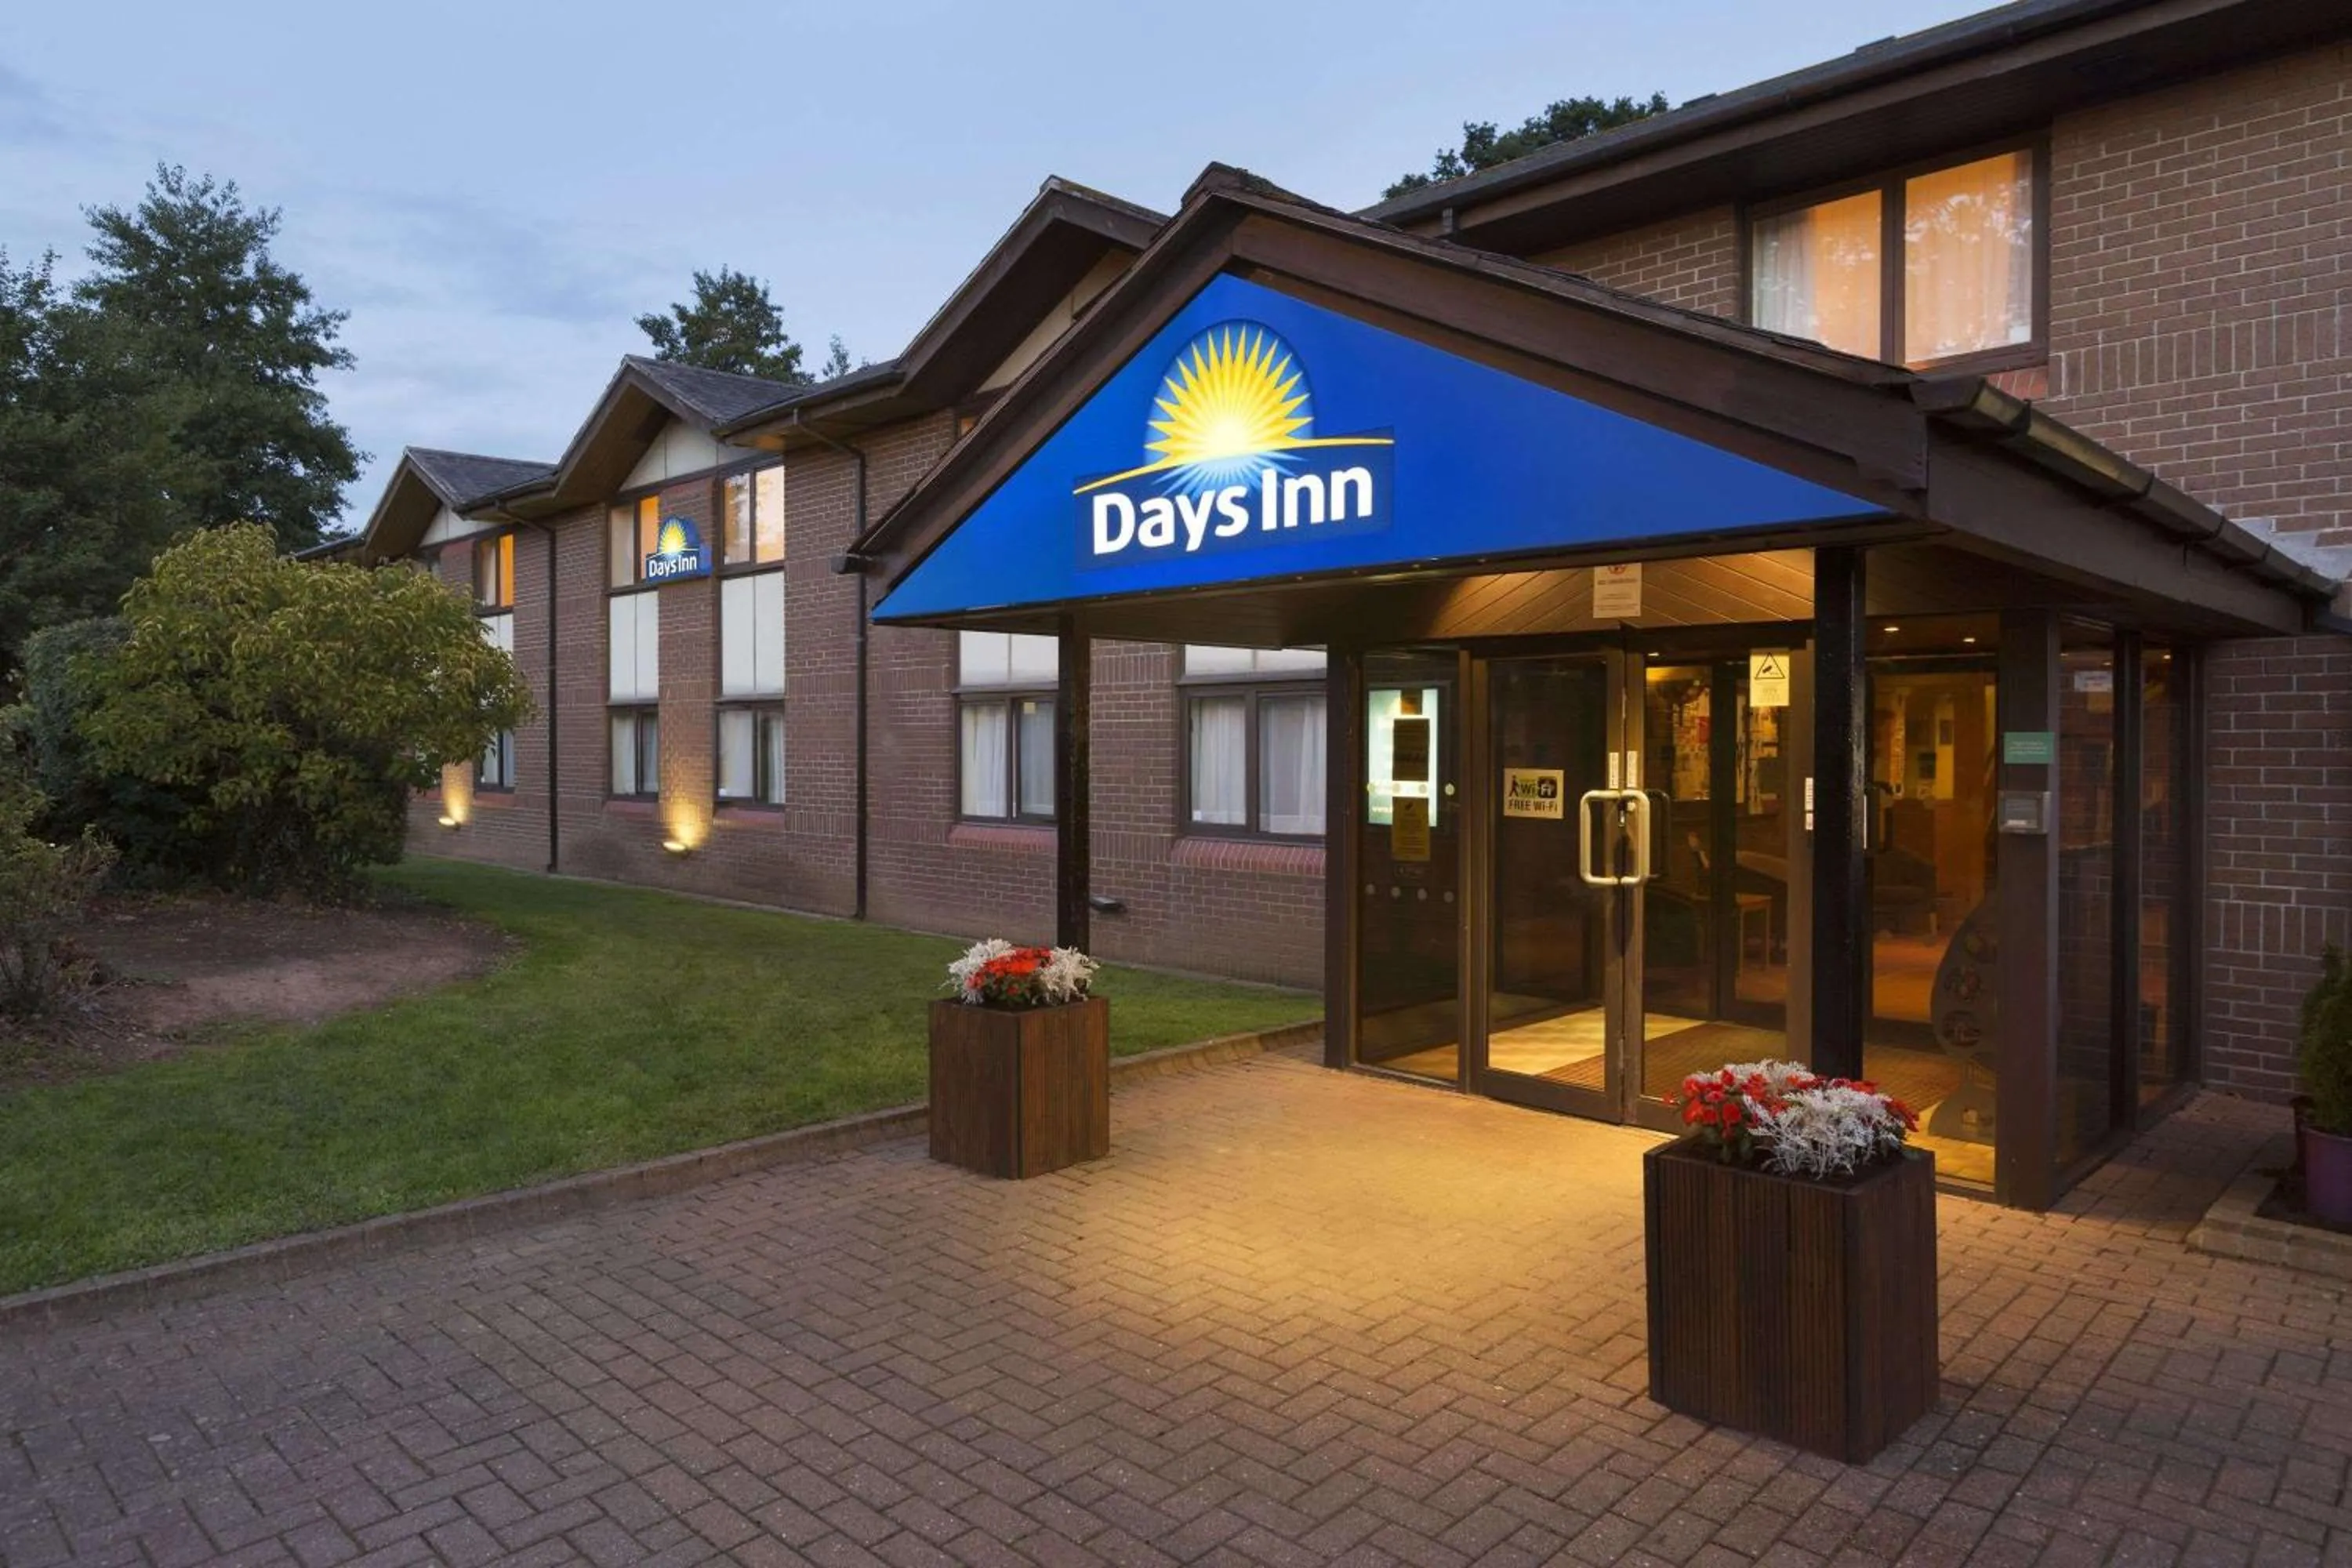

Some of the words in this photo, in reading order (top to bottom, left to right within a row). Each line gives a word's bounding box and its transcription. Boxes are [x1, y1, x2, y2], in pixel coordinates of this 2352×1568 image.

[1093, 485, 1250, 554] Days
[1261, 466, 1374, 532] Inn
[648, 559, 677, 578] Days
[678, 554, 697, 573] Inn
[1508, 799, 1531, 811] FREE
